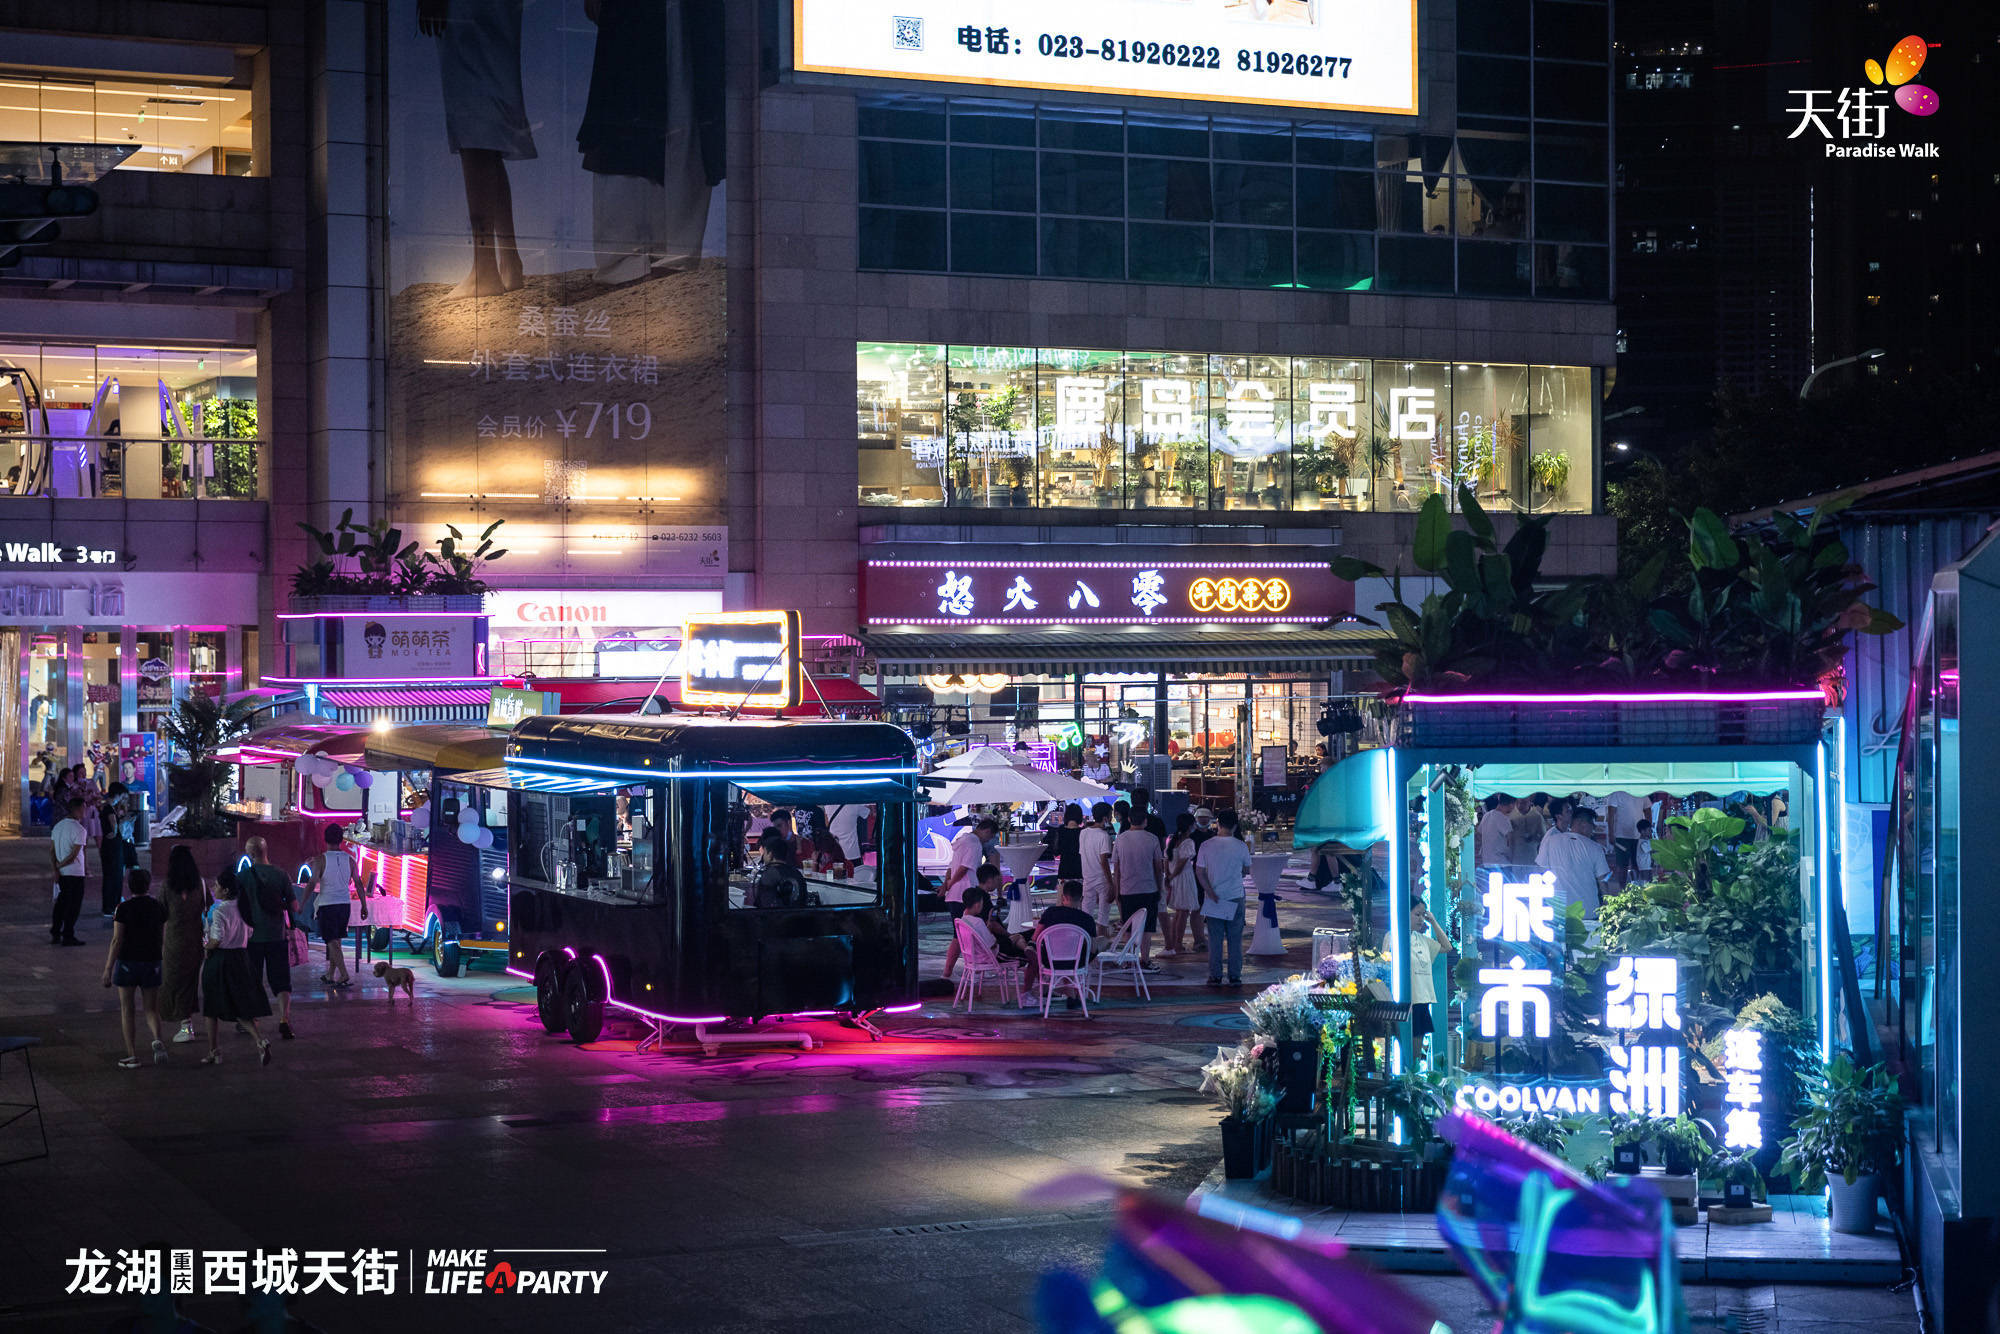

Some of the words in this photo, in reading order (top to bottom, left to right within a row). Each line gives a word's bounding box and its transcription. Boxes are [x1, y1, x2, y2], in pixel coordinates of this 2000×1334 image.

[1038, 33, 1221, 69] 023-81926222
[1237, 49, 1353, 79] 81926277
[518, 306, 612, 338] 桑蚕丝
[469, 349, 660, 385] 外套式连衣裙
[477, 414, 547, 439] 会员价
[702, 532, 722, 542] 5603
[5, 542, 63, 563] Walk
[1193, 580, 1285, 608] 牛肉串串
[517, 602, 606, 622] Canon
[391, 631, 450, 648] 萌萌茶
[391, 649, 420, 657] MOE
[429, 649, 451, 657] TEA
[1479, 870, 1557, 1039] 城市
[1605, 957, 1682, 1118] 绿洲
[1455, 1084, 1600, 1113] COOLVAN
